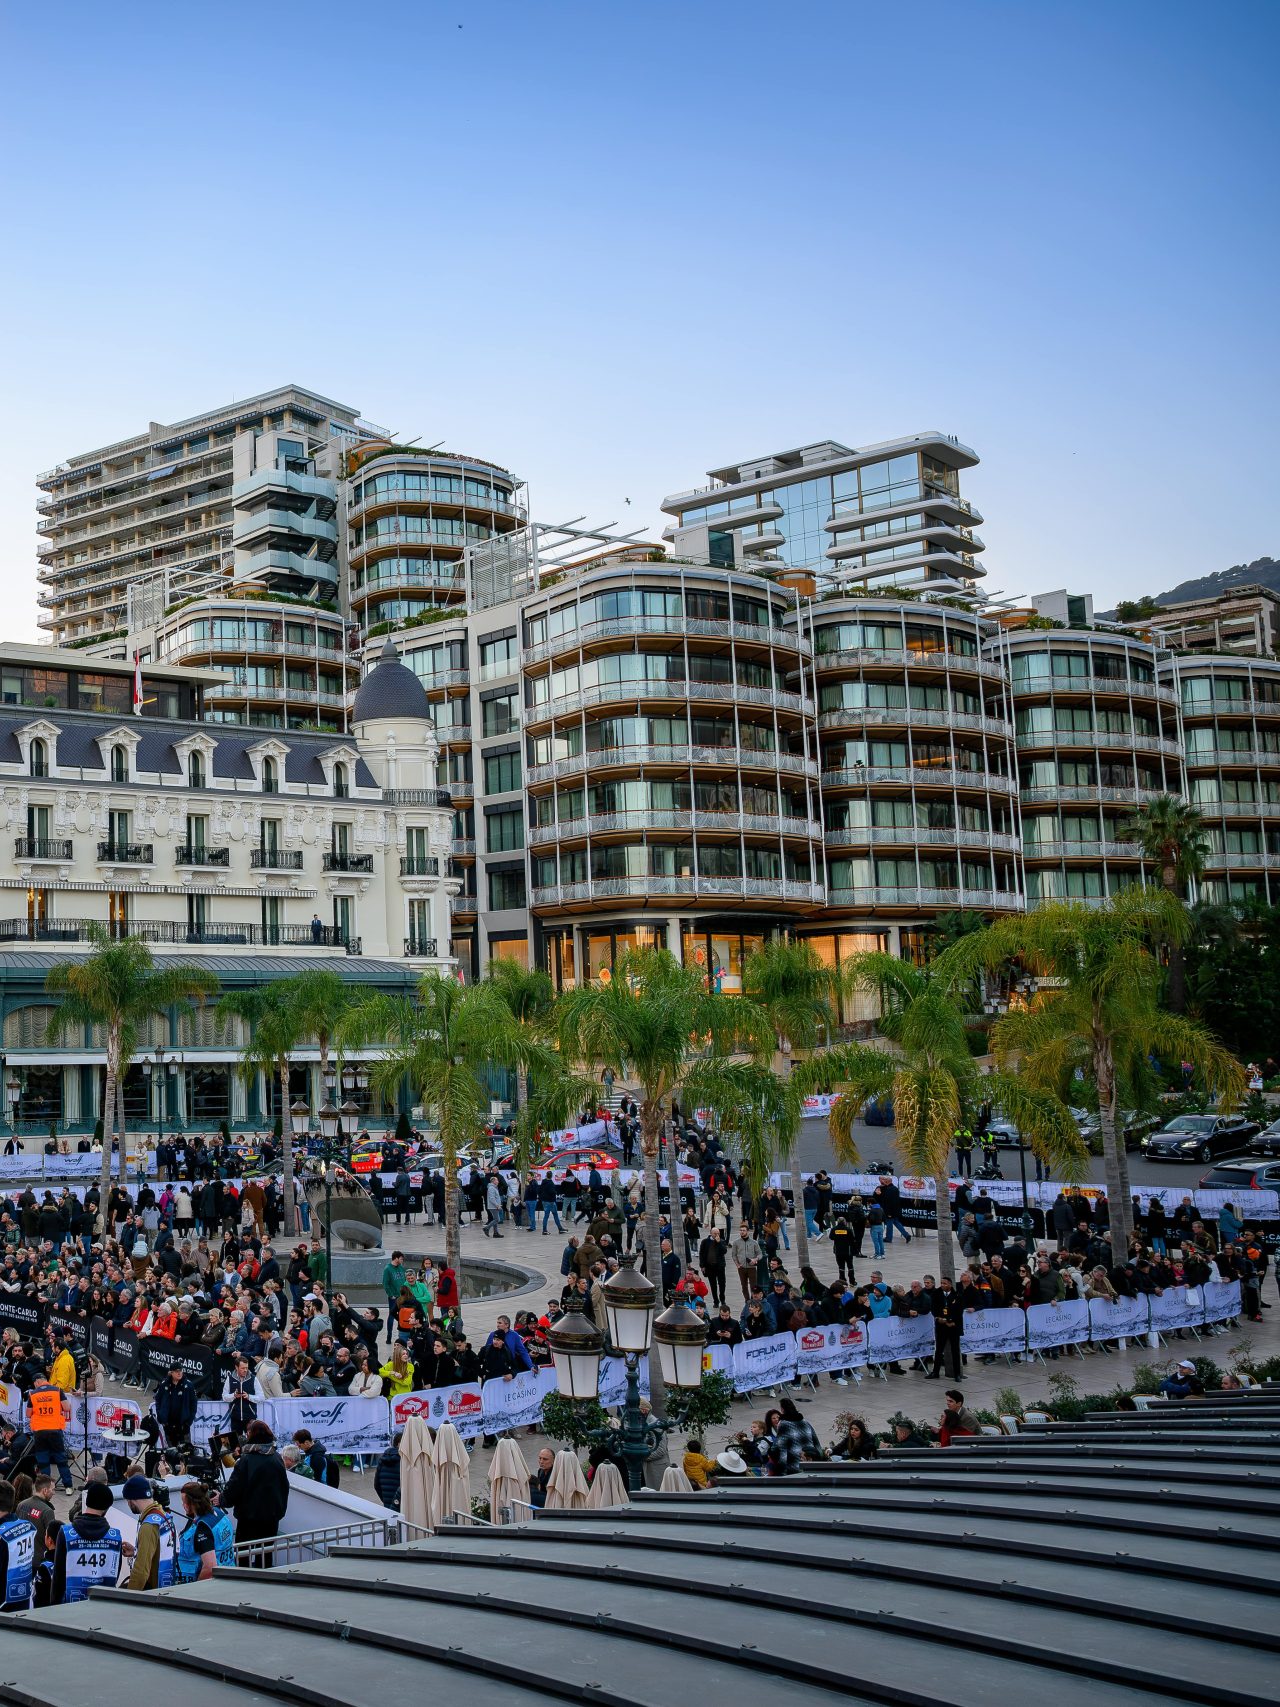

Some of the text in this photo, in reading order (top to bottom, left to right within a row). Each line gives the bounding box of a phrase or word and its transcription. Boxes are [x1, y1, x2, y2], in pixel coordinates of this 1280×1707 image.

[1113, 1306, 1132, 1316] CASINO
[1053, 1313, 1072, 1323] CASINO
[50, 1315, 86, 1334] MONTE-CARLO
[969, 1321, 1000, 1330] CASINO
[896, 1327, 916, 1336] CASINO
[96, 1332, 133, 1352] MON-CARLO
[746, 1343, 786, 1359] FORUM8
[148, 1350, 203, 1370] MONTE-CARLO
[504, 1387, 537, 1402] LE CASINO
[38, 1407, 54, 1415] 130
[30, 1508, 41, 1517] USA
[76, 1553, 107, 1568] 448
